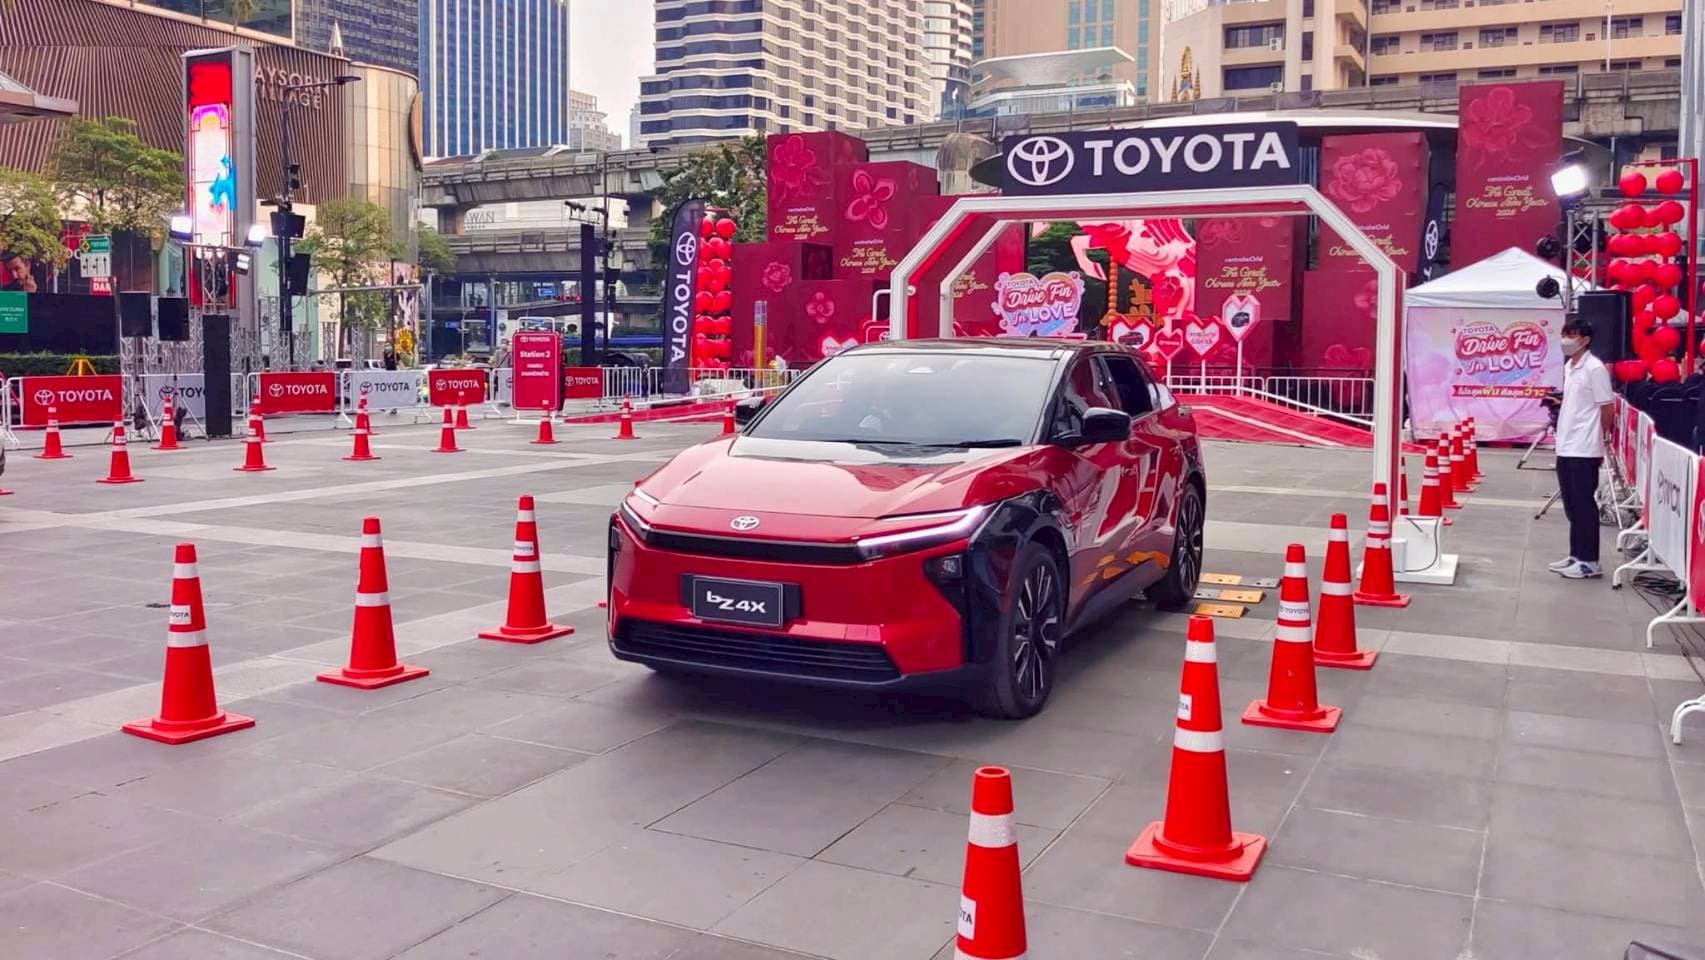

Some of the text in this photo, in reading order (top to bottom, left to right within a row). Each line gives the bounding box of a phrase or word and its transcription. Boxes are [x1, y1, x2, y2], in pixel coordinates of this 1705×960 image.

[254, 66, 328, 95] AYSORN
[262, 84, 320, 110] ILLAGE
[1084, 132, 1290, 176] TOYOTA
[1006, 283, 1072, 308] Drive Fin
[671, 271, 691, 362] TOYOTA
[1029, 303, 1075, 323] LOVE
[1463, 326, 1494, 334] TOYOTA
[1461, 330, 1538, 356] Drive Fin
[1488, 352, 1541, 371] LOVE
[286, 384, 328, 396] TOYOTA
[374, 382, 410, 393] TOYOTA
[447, 380, 479, 390] TOYOTA
[575, 377, 599, 385] TOYOTA
[57, 389, 113, 403] TOYOTA
[178, 386, 204, 398] TOY
[706, 591, 767, 613] bZ4X
